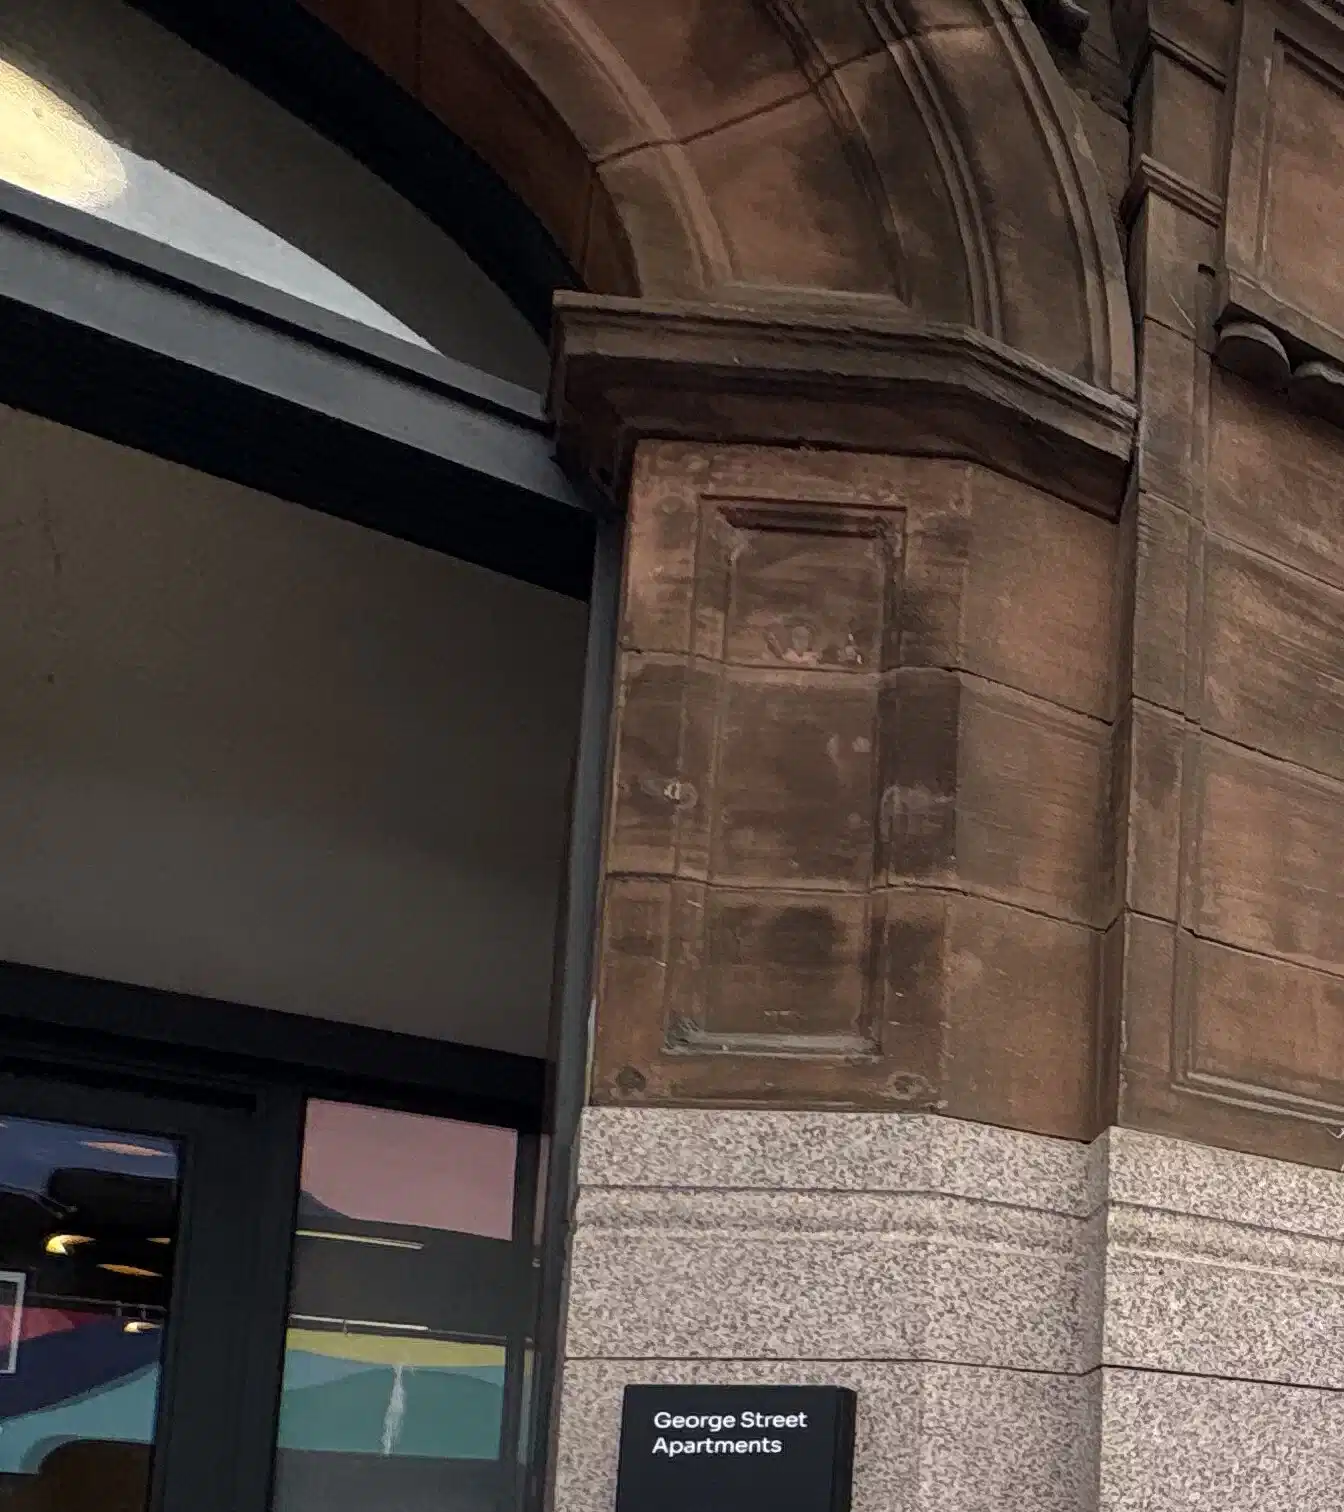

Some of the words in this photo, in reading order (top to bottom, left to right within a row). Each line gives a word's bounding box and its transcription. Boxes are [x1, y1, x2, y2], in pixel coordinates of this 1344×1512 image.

[653, 1411, 735, 1431] George
[740, 1411, 807, 1428] Street
[651, 1437, 782, 1457] Apartments
